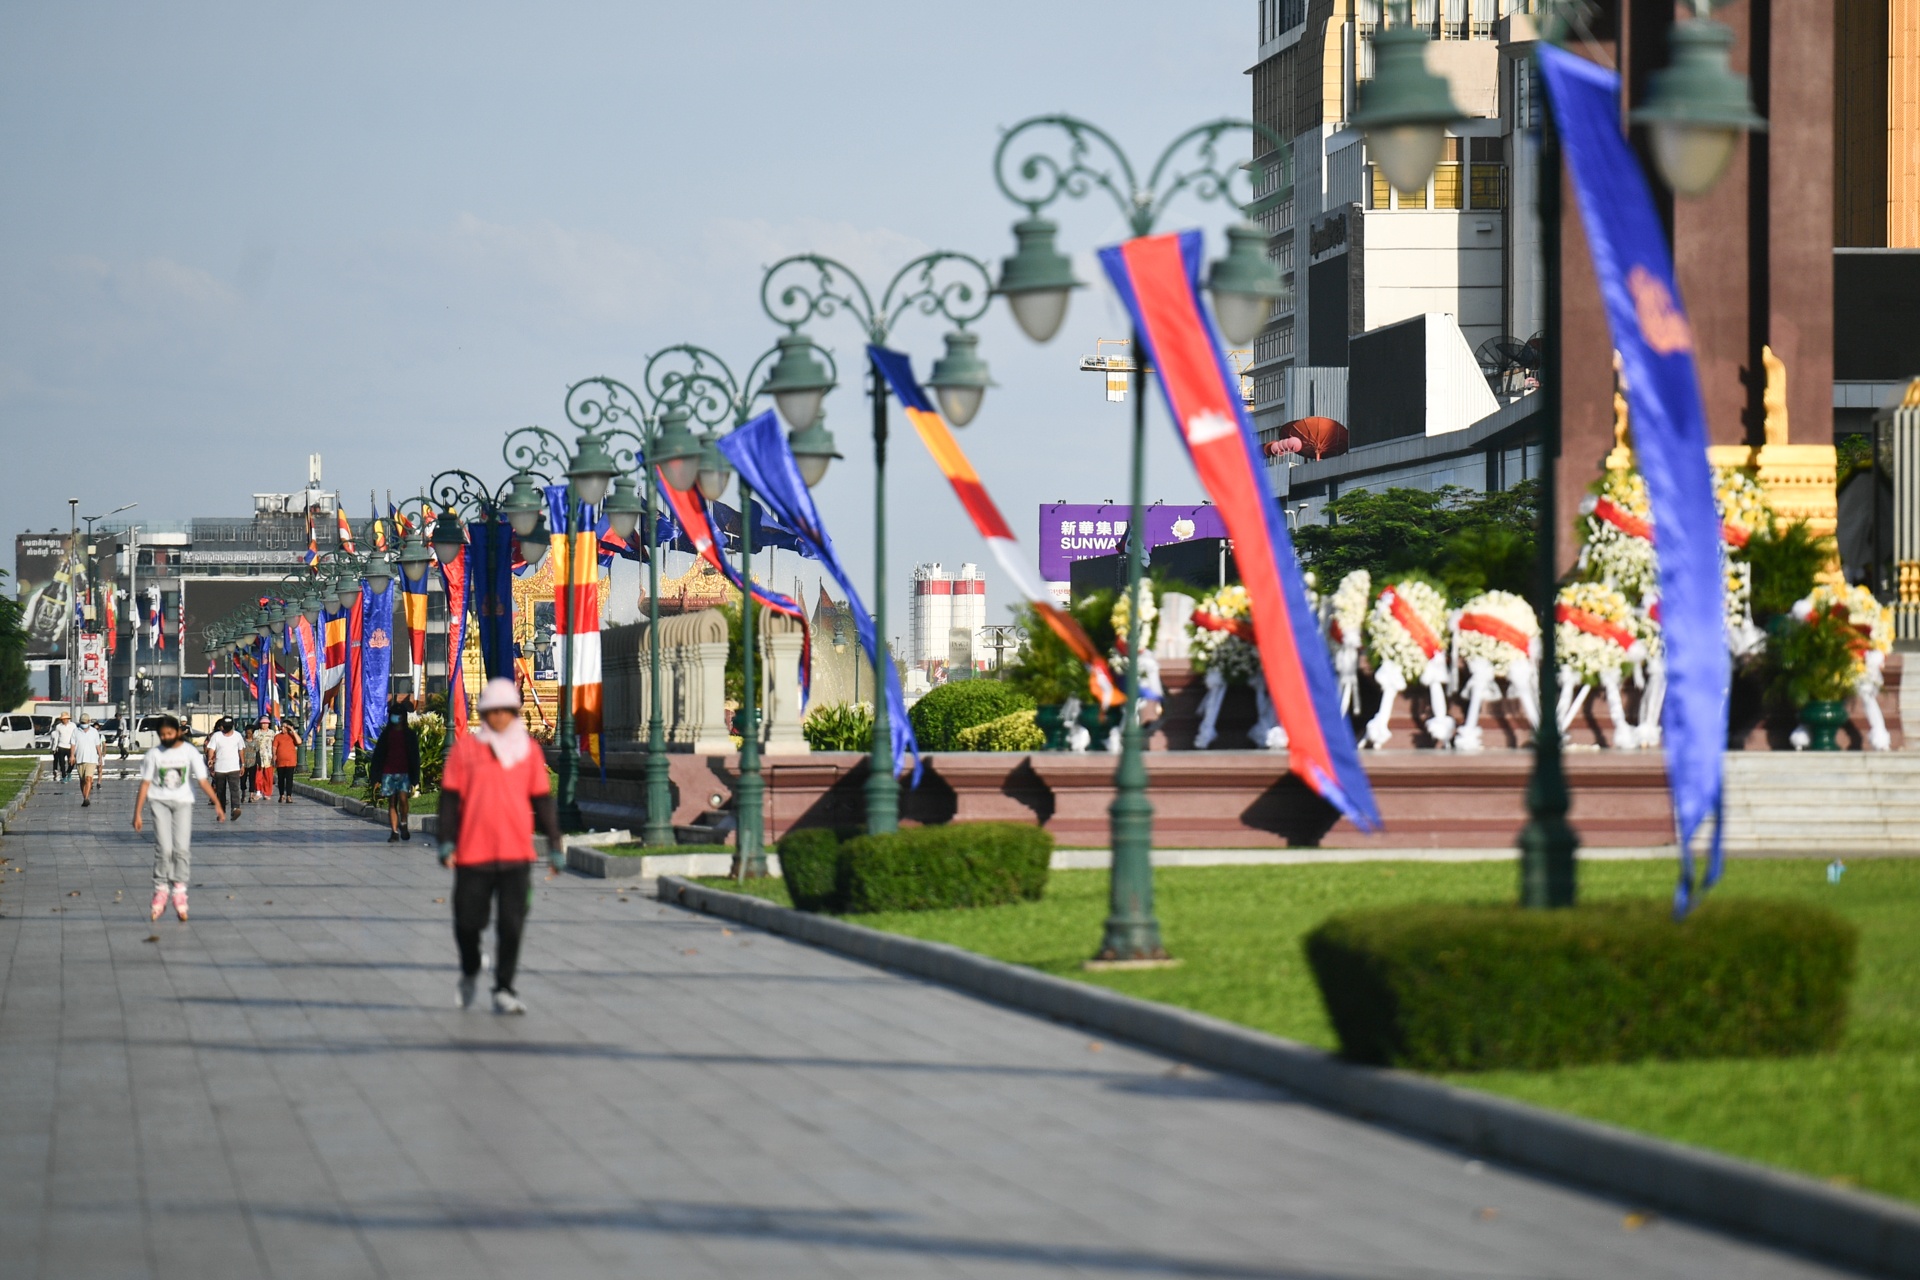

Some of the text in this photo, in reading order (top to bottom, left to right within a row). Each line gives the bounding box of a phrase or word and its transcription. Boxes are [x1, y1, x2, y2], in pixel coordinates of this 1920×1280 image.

[1061, 521, 1127, 536] 新華集團
[1060, 537, 1121, 549] SUNWA
